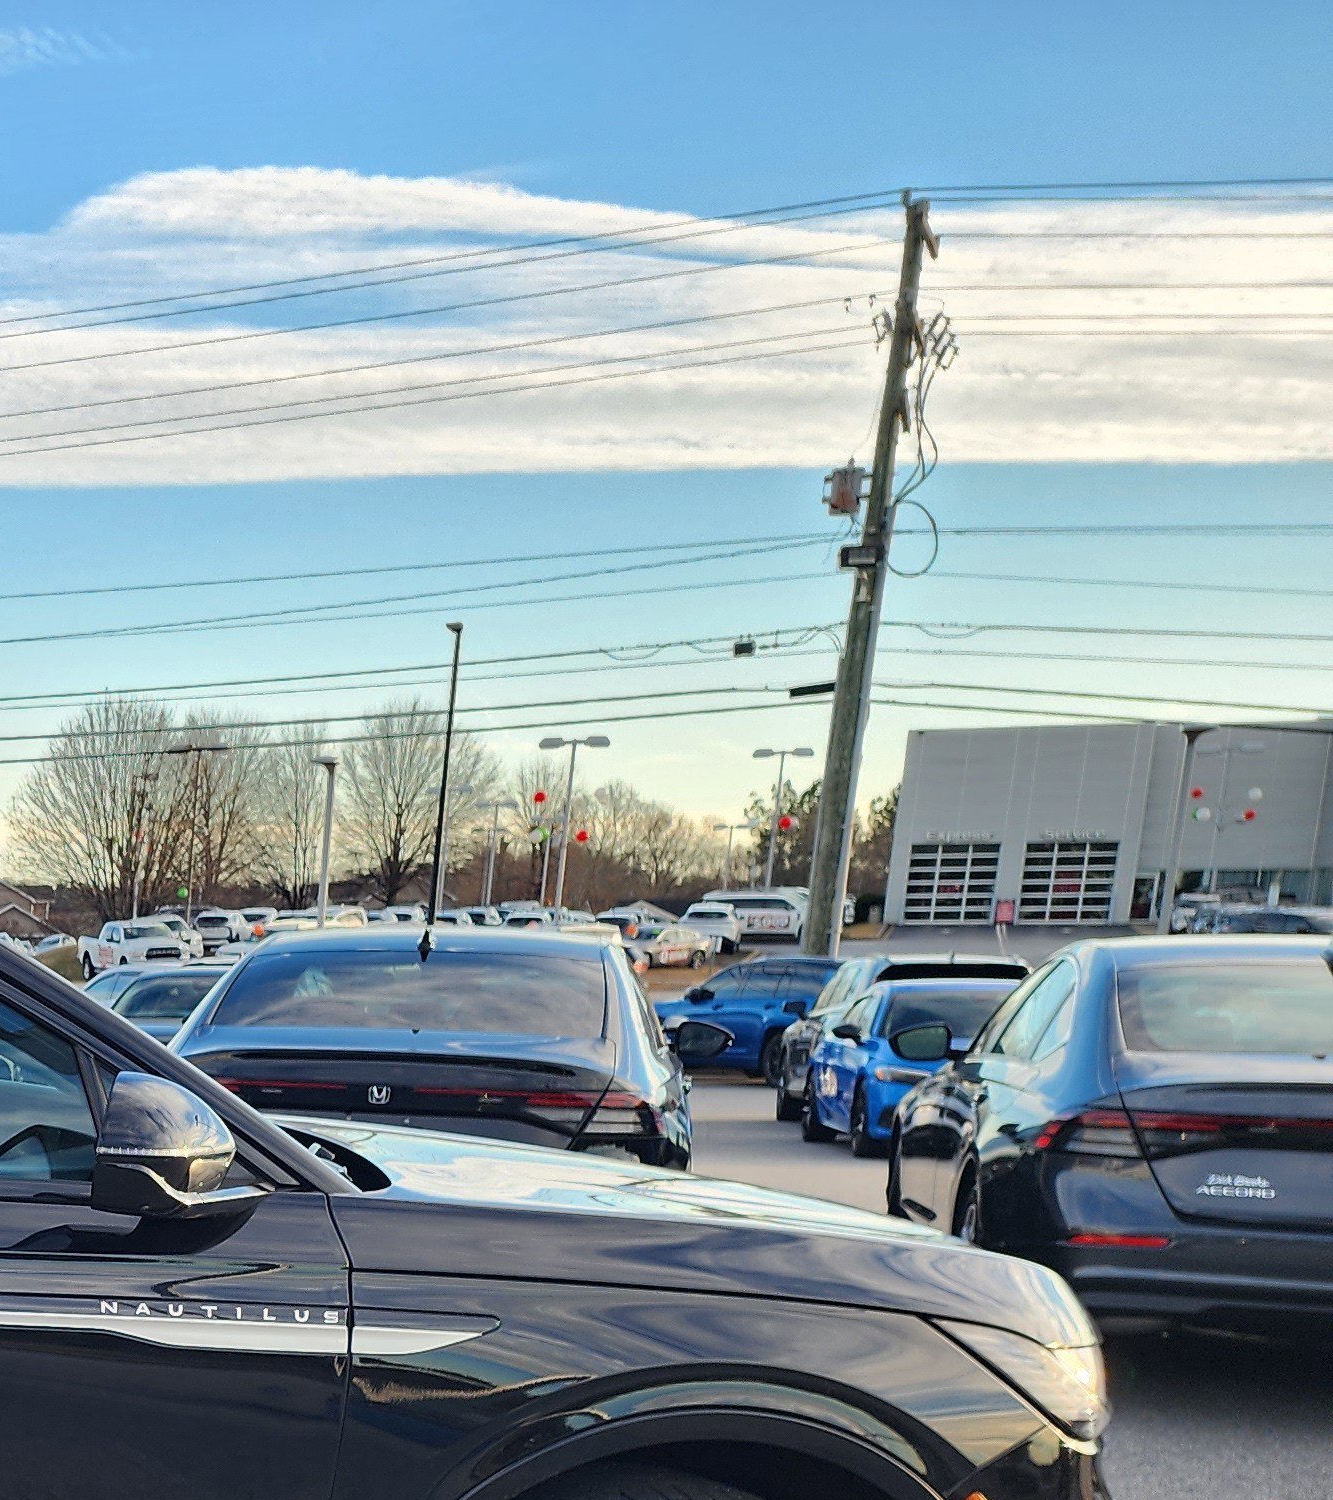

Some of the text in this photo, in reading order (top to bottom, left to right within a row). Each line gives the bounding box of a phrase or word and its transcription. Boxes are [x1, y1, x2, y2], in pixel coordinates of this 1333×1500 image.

[926, 828, 1106, 843] Express Service
[1196, 1185, 1276, 1200] ACCORD
[100, 1301, 339, 1324] NAUTILUS
